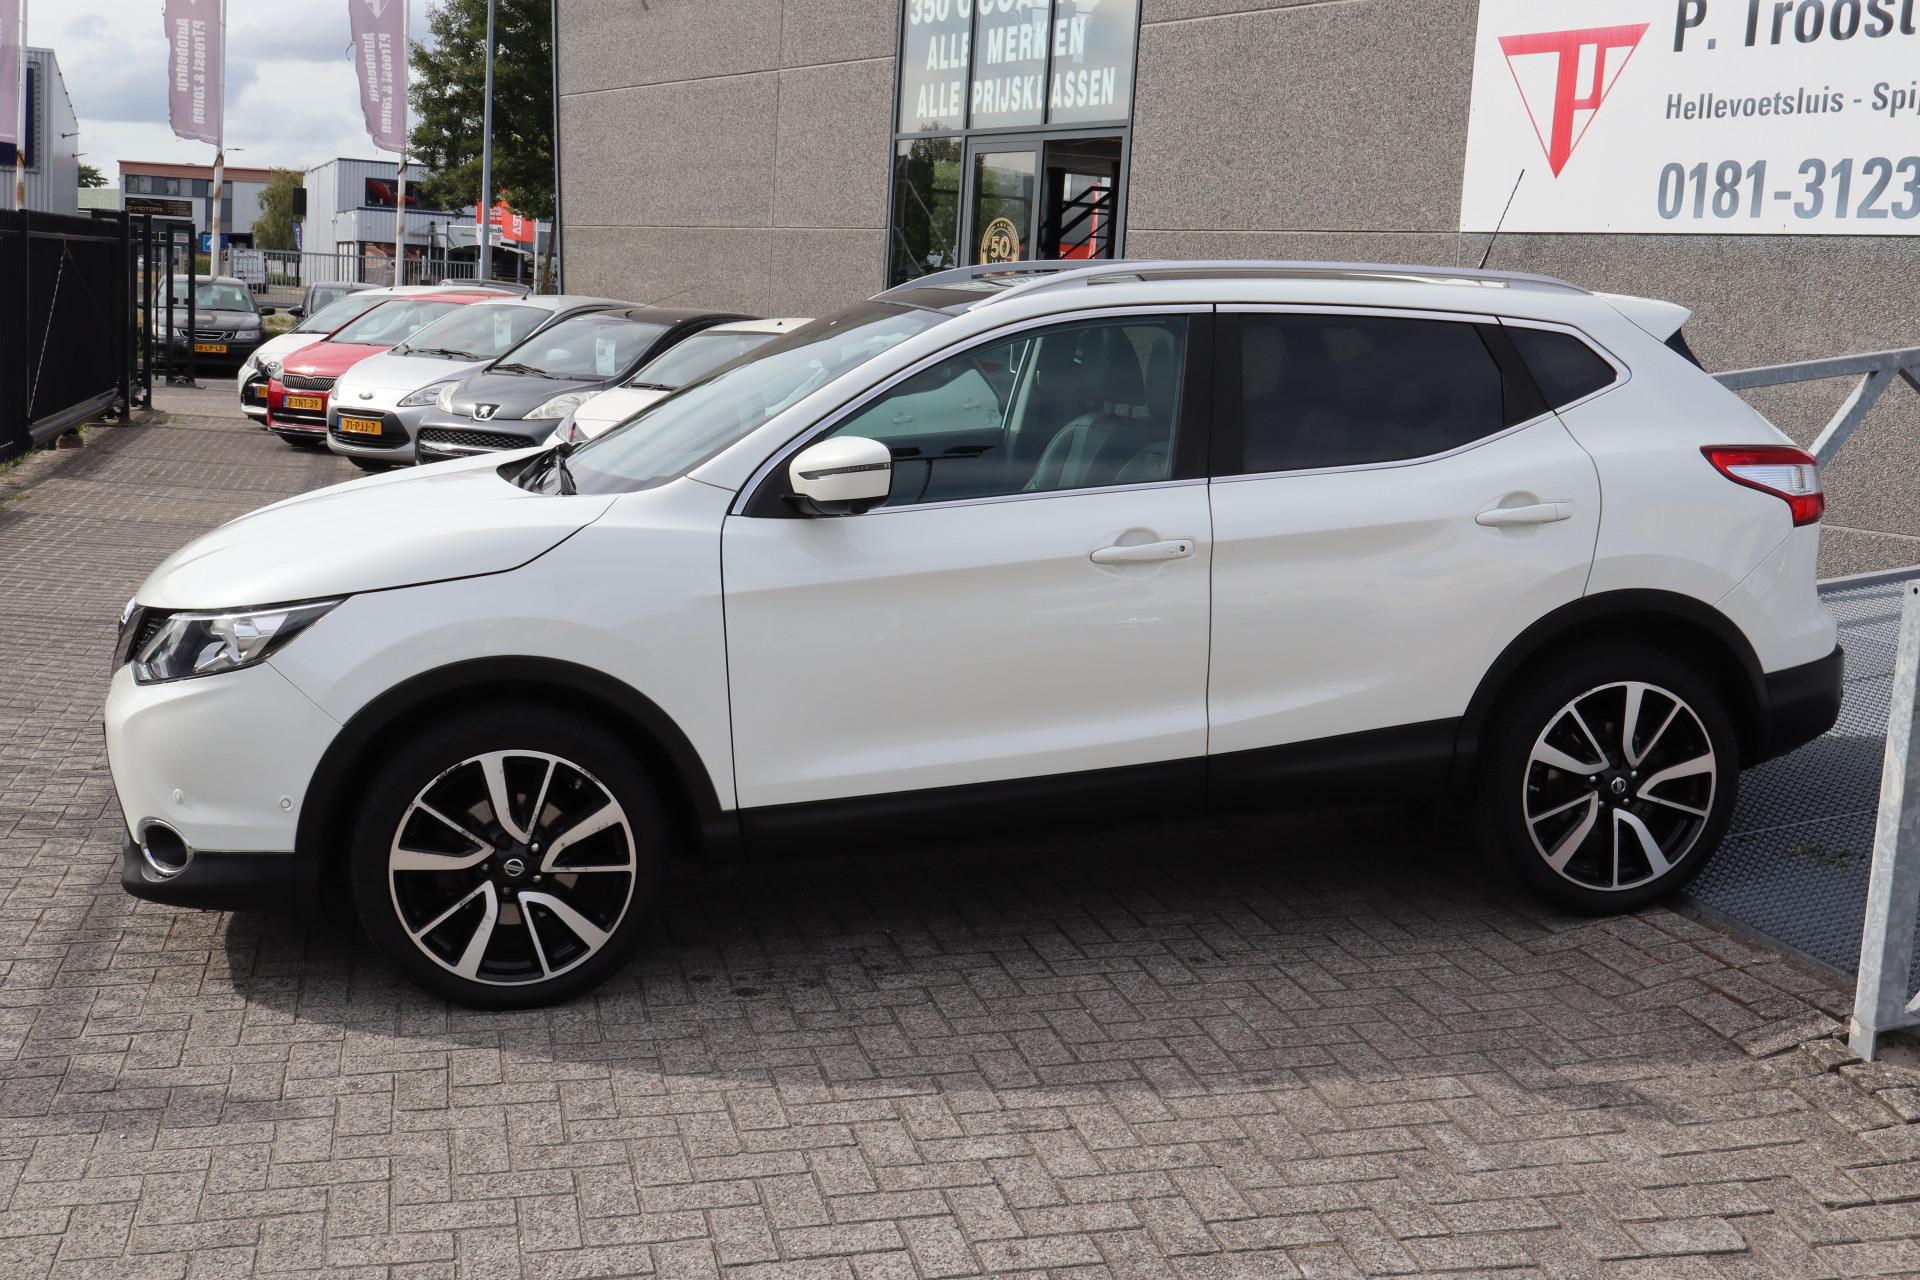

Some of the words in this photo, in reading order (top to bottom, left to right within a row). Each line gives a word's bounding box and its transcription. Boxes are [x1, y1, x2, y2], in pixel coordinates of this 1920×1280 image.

[926, 32, 968, 71] ALLE
[987, 16, 1086, 64] MERKEN
[1673, 0, 1717, 52] P.
[916, 81, 961, 118] ALLE
[971, 67, 1116, 115] PRIJSKLASSEN
[1665, 85, 1845, 120] Hellevoetsluis
[1871, 81, 1920, 118] Spi
[1657, 156, 1920, 220] 0181-3123
[990, 236, 1010, 258] 50
[288, 397, 319, 409] 7-TNT-39
[345, 418, 376, 432] 71-PJJ-7
